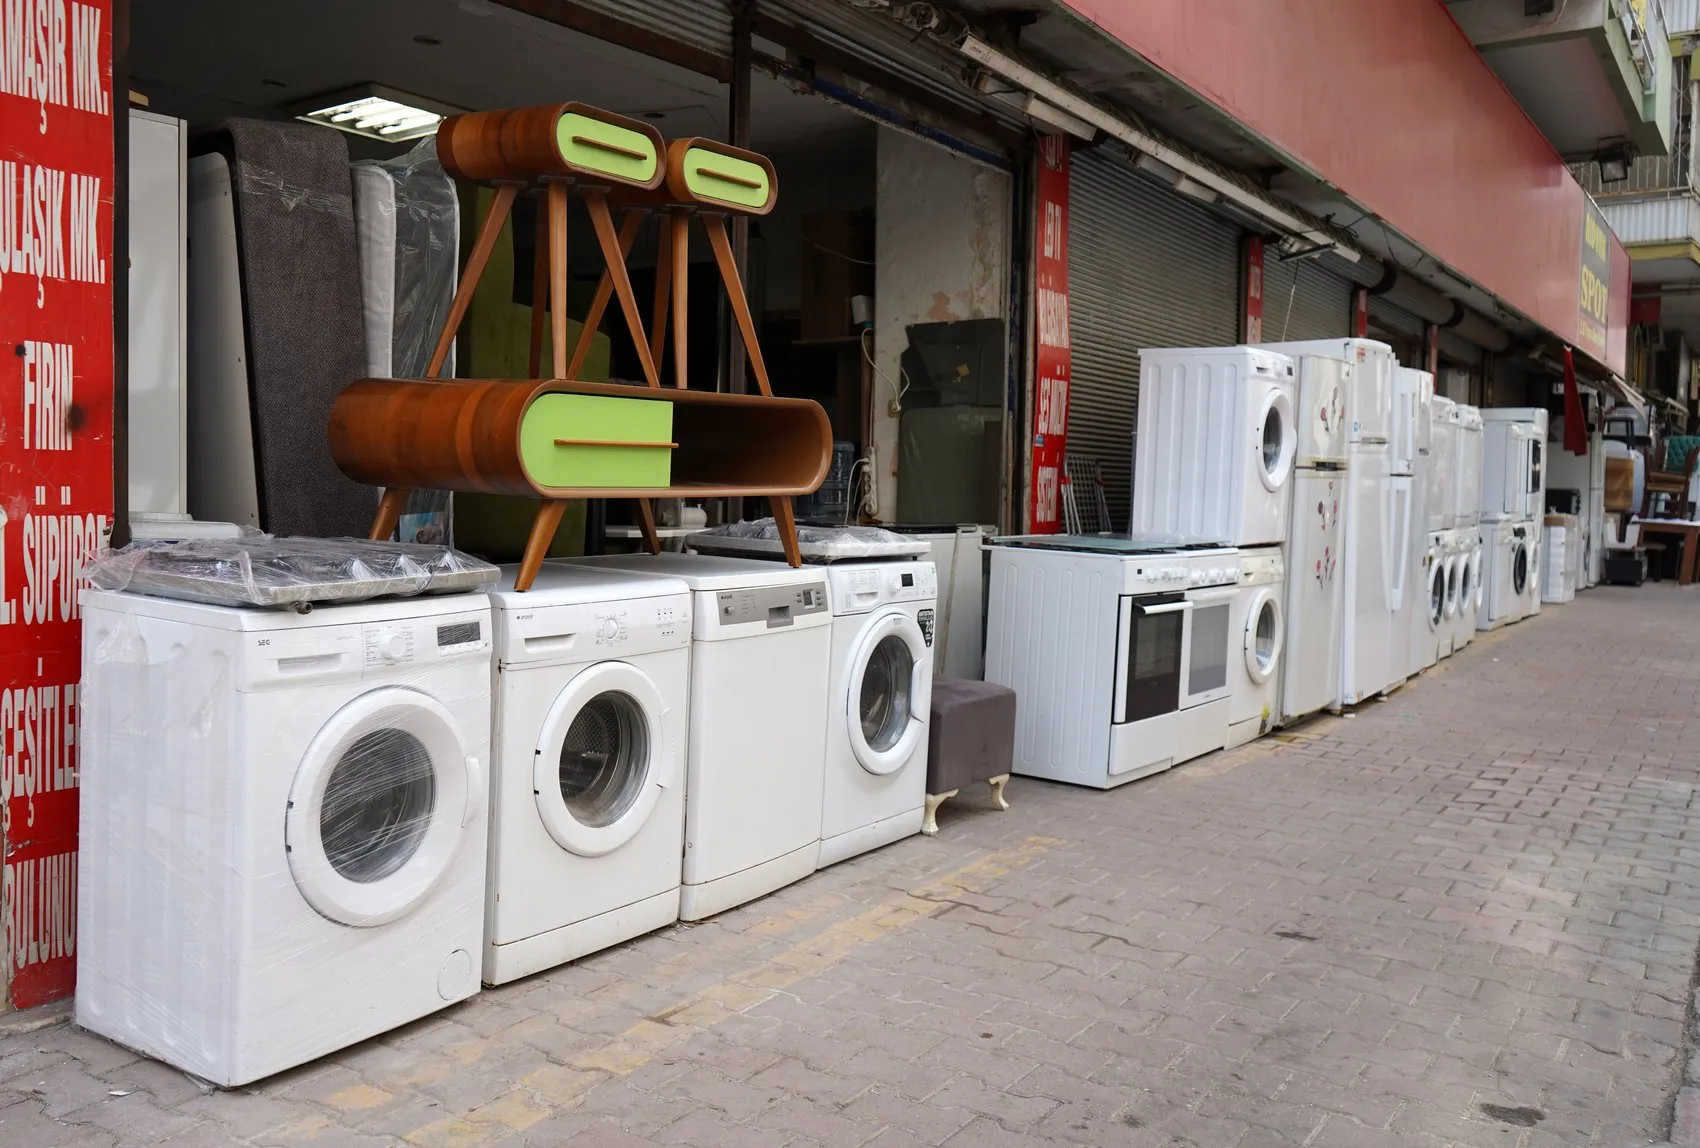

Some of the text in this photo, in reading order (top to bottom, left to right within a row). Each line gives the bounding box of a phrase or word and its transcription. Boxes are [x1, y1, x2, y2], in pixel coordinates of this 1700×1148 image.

[72, 2, 109, 115] MK.
[70, 173, 106, 284] MK.
[1580, 264, 1608, 324] SPOT
[24, 340, 73, 450] FIRIN
